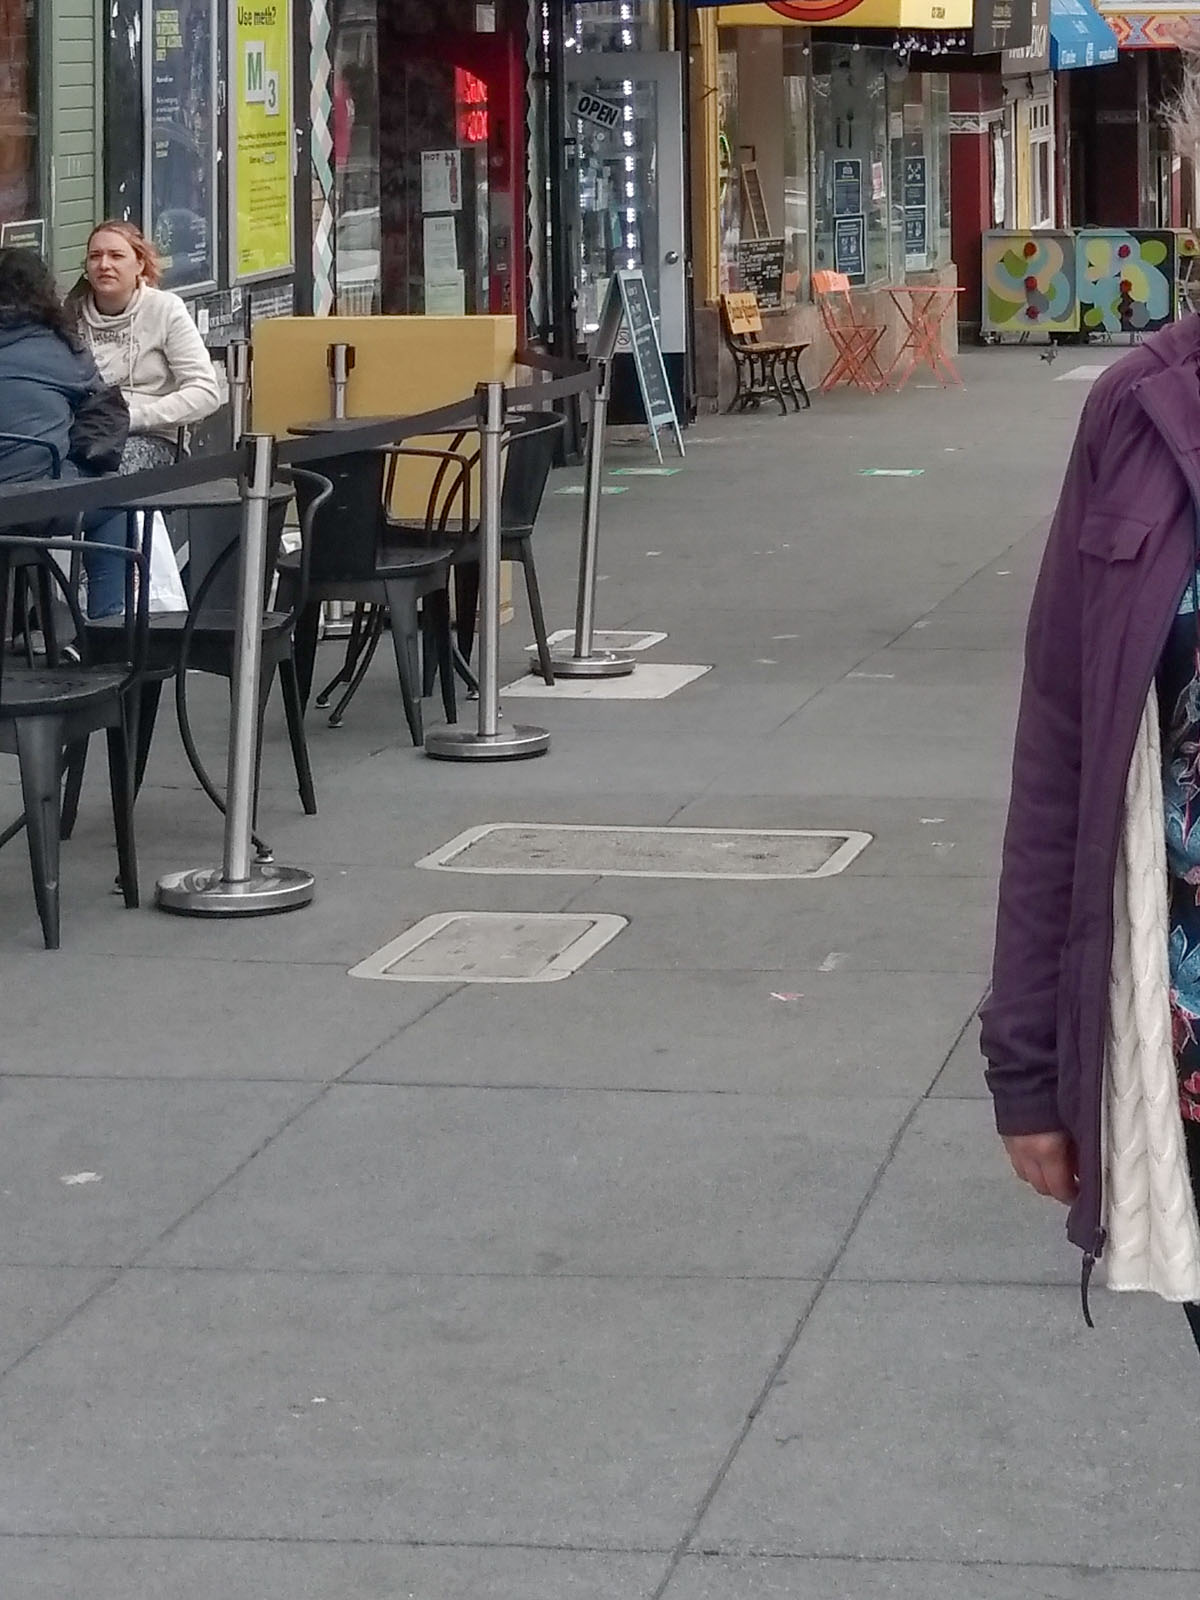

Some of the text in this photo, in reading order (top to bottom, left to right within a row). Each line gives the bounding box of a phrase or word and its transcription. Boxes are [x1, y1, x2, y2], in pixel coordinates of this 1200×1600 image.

[237, 6, 277, 26] Use meth?
[247, 52, 262, 91] M
[268, 78, 276, 108] 3
[578, 96, 619, 126] OPEN
